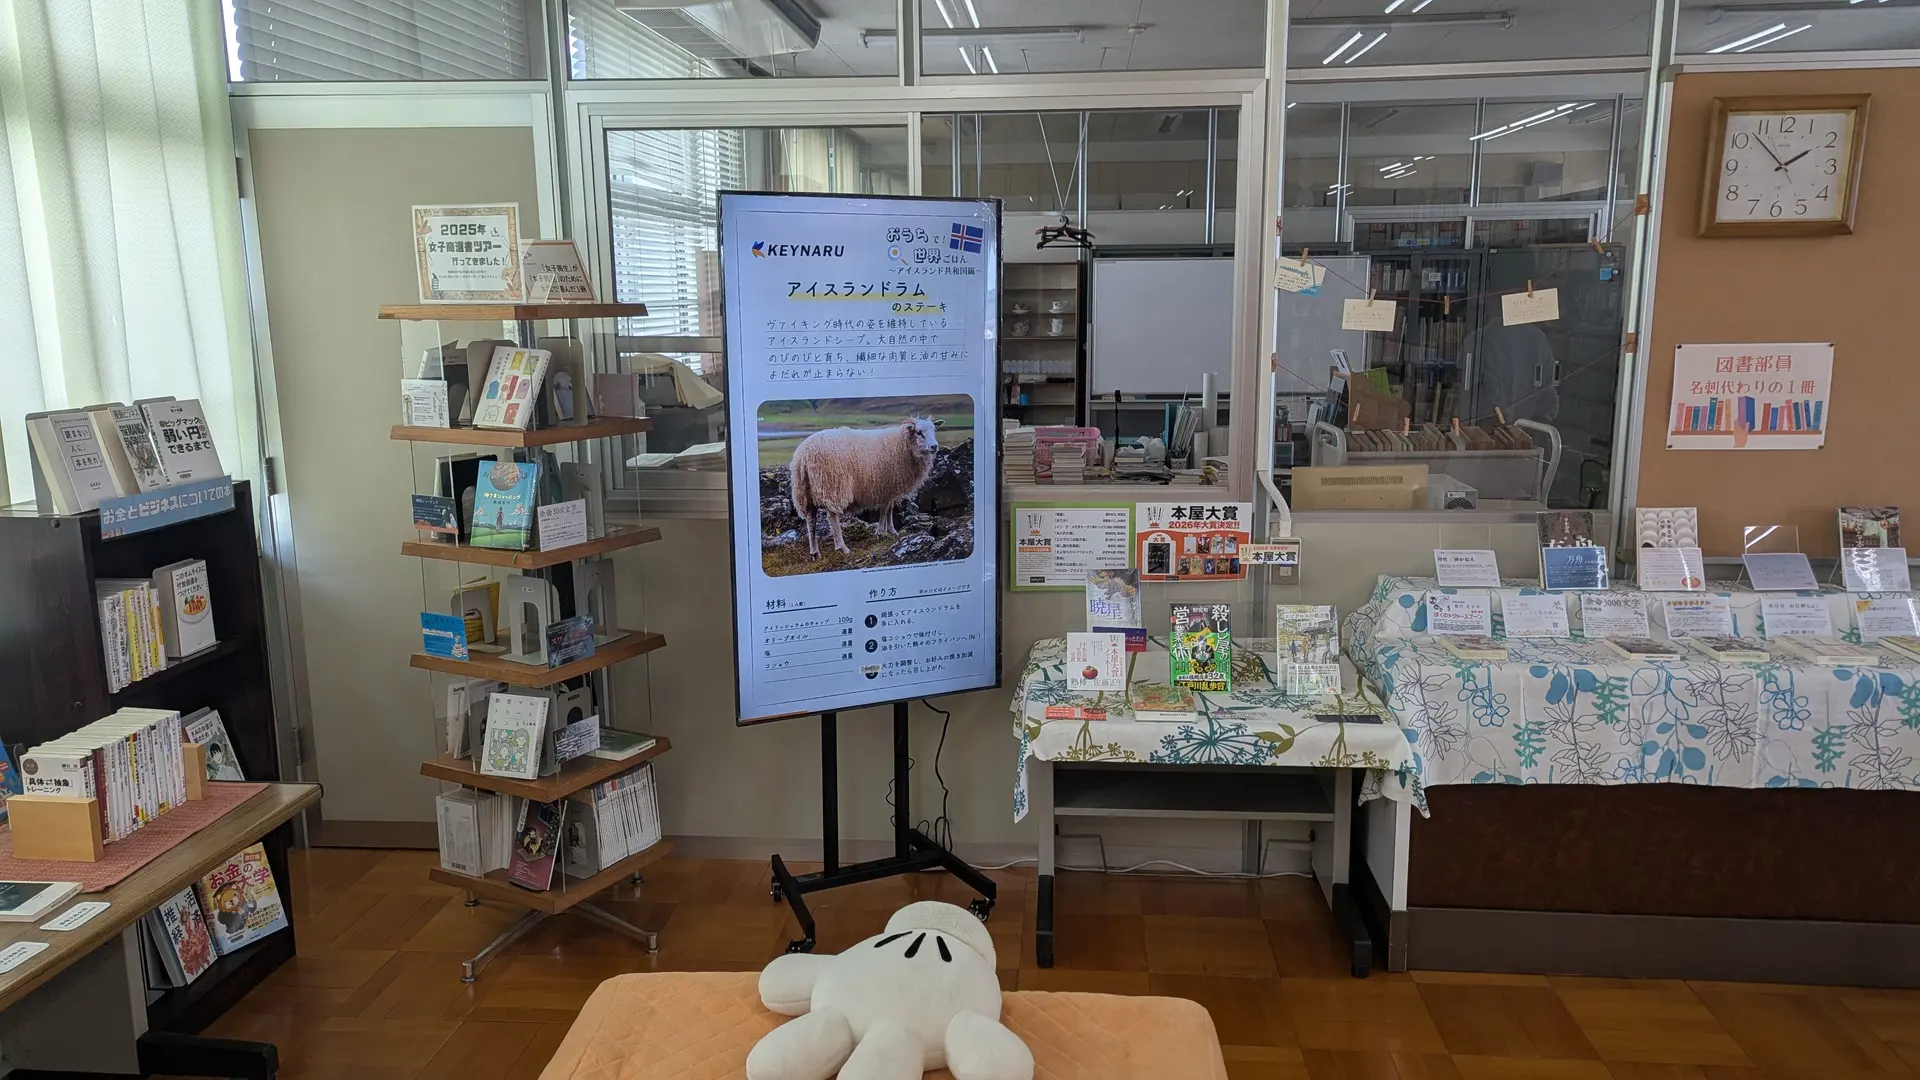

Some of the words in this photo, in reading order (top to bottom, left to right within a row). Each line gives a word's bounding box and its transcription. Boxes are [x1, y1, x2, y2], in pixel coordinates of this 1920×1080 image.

[1758, 119, 1770, 135] 11
[1780, 117, 1796, 133] 12
[1809, 119, 1814, 134] 1
[1731, 133, 1749, 149] 10
[1824, 132, 1837, 148] 2
[1726, 159, 1738, 176] 9
[1824, 158, 1837, 175] 3
[1726, 185, 1739, 200] 8
[1815, 185, 1829, 201] 4
[1748, 199, 1761, 215] 7
[1770, 200, 1782, 217] 6
[1794, 199, 1807, 215] 5
[440, 223, 486, 236] 2025年
[428, 240, 502, 252] 女子商選書ツアー
[767, 244, 845, 257] KEYNARU
[451, 257, 506, 266] 行ってきました！
[913, 247, 968, 264] 世界ごはん
[787, 281, 926, 298] アイスランドラム
[891, 302, 948, 313] のステーキ
[767, 318, 947, 330] ヴァイキング時代の姿を維持している
[768, 334, 939, 346] アイスランドシープ。大自然の中で
[768, 350, 968, 363] のびのびと育ち、繊細な肉質と油の甘みに
[1715, 355, 1793, 374] 図書部員
[769, 368, 875, 380] よだれが止まらない！
[1689, 380, 1816, 396] 名刺代わりの1冊
[64, 429, 88, 439] 読まない
[167, 440, 211, 454] できるまで
[102, 484, 232, 525] お金とビジネスについての本
[1170, 506, 1239, 521] 本屋大賞
[1168, 521, 1240, 530] 2026年大賞決定!!
[1019, 538, 1052, 546] 本屋大賞
[1252, 551, 1297, 562] 本屋大賞
[177, 584, 204, 597] つけてください
[869, 587, 897, 599] 作り方
[766, 599, 786, 610] 材料
[1090, 598, 1123, 620] 暁星
[1586, 598, 1641, 609] 余命3000文字
[838, 616, 853, 624] 100g
[881, 618, 915, 628] 手に入れる。
[765, 634, 808, 643] オリーブオイル
[1172, 605, 1192, 661] 営業術
[1211, 604, 1230, 661] 殺し屋の
[766, 660, 789, 669] コショウ
[208, 863, 253, 890] お金の
[236, 866, 271, 891] 大学
